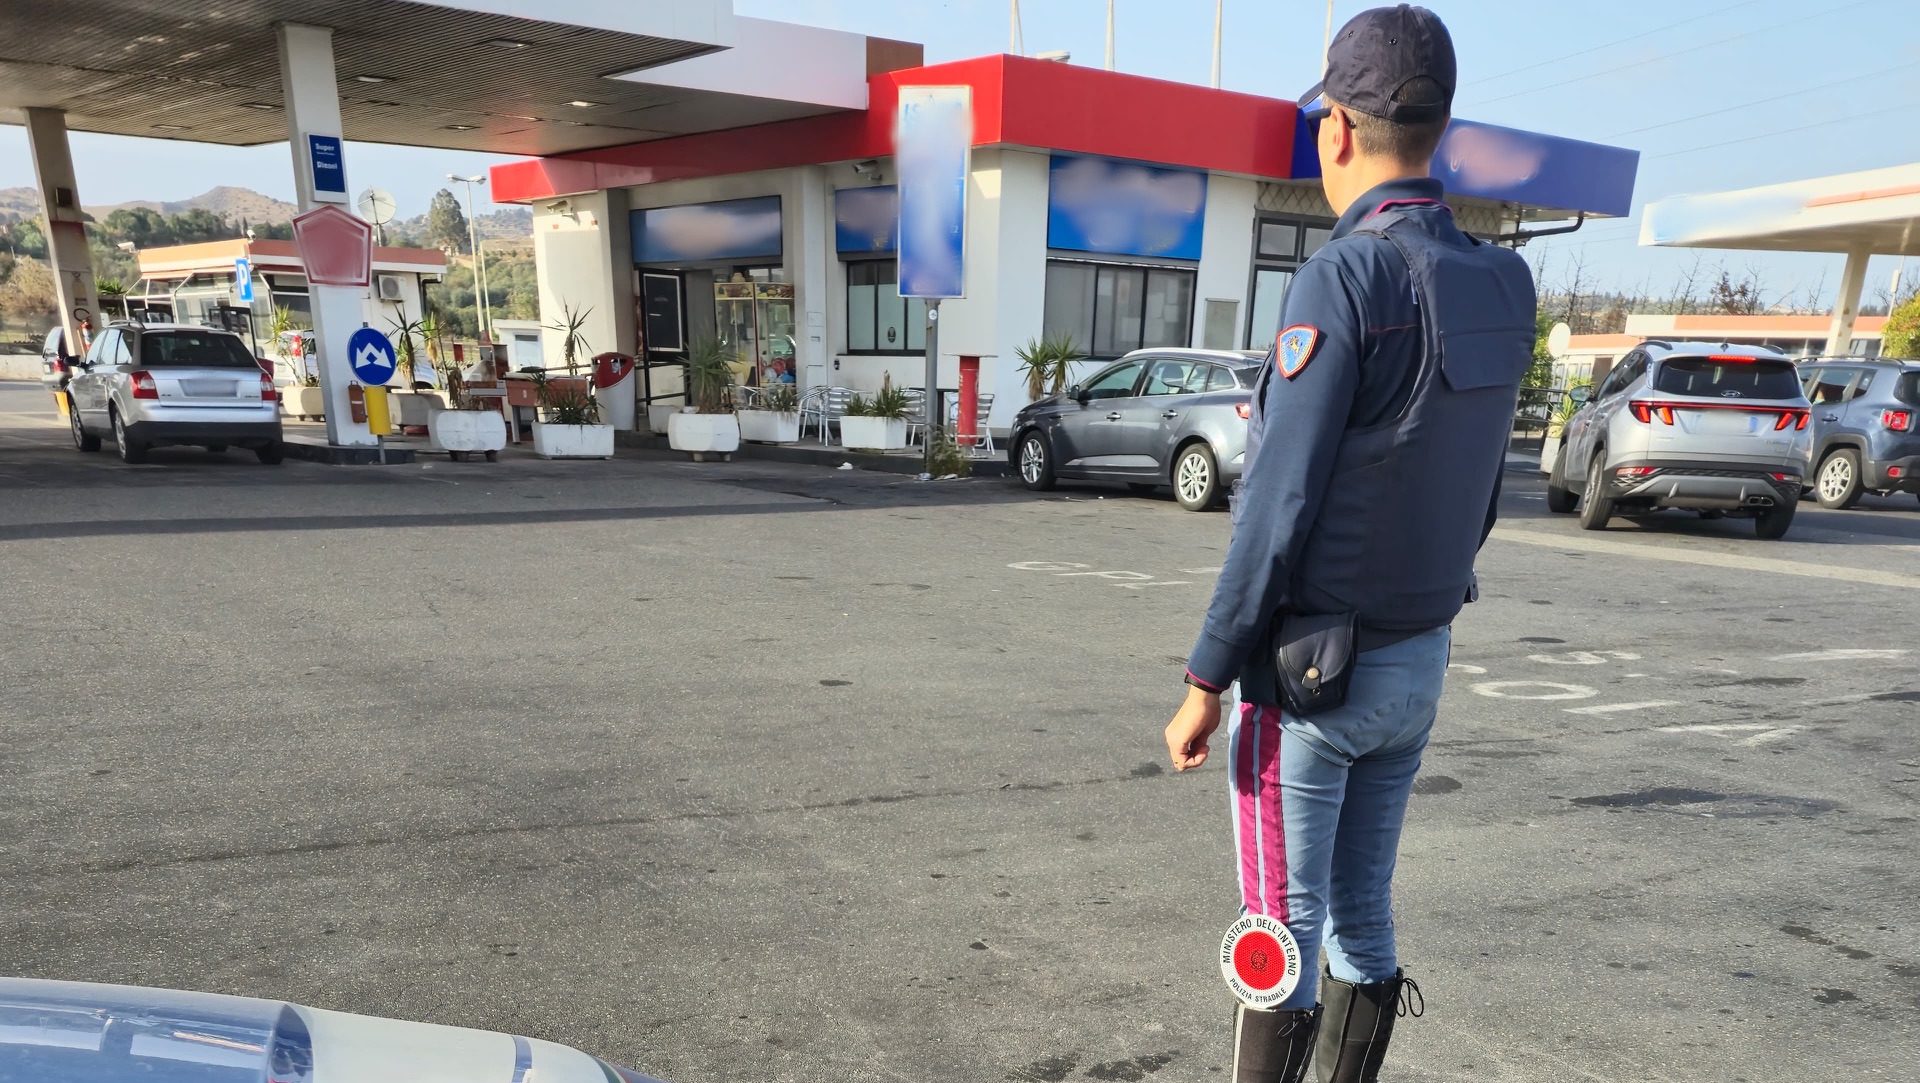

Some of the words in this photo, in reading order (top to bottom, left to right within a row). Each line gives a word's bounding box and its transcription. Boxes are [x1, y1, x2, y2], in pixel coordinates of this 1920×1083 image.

[238, 264, 248, 296] P
[1223, 918, 1252, 964] MINISTERO
[1256, 918, 1297, 976] DELL'INTERNO
[1229, 978, 1252, 1000] POLIZIA
[1254, 987, 1287, 1003] STRADALE
